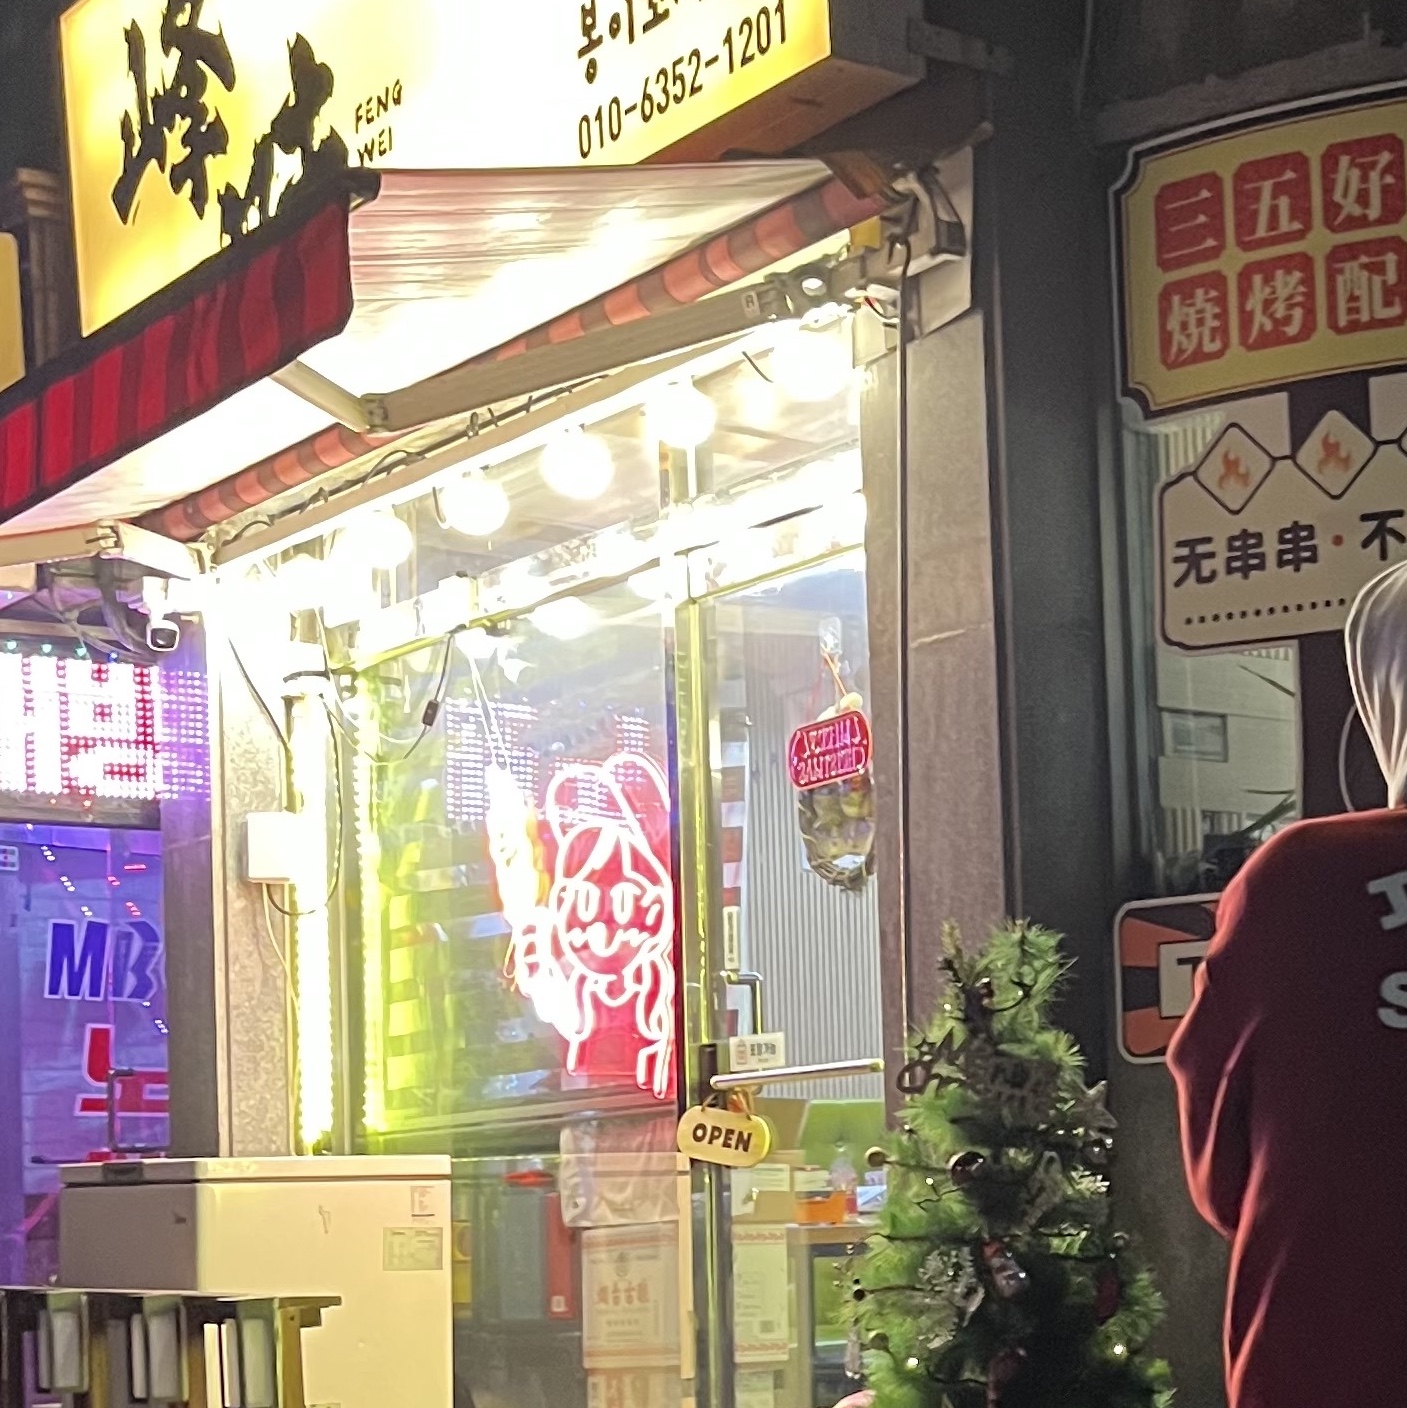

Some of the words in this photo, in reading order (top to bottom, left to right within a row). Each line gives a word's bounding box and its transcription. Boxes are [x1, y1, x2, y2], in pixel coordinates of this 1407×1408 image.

[579, 0, 787, 159] 010-6352-1201
[355, 79, 403, 133] FENG
[357, 127, 393, 166] WEI
[691, 1122, 753, 1153] OPEN
